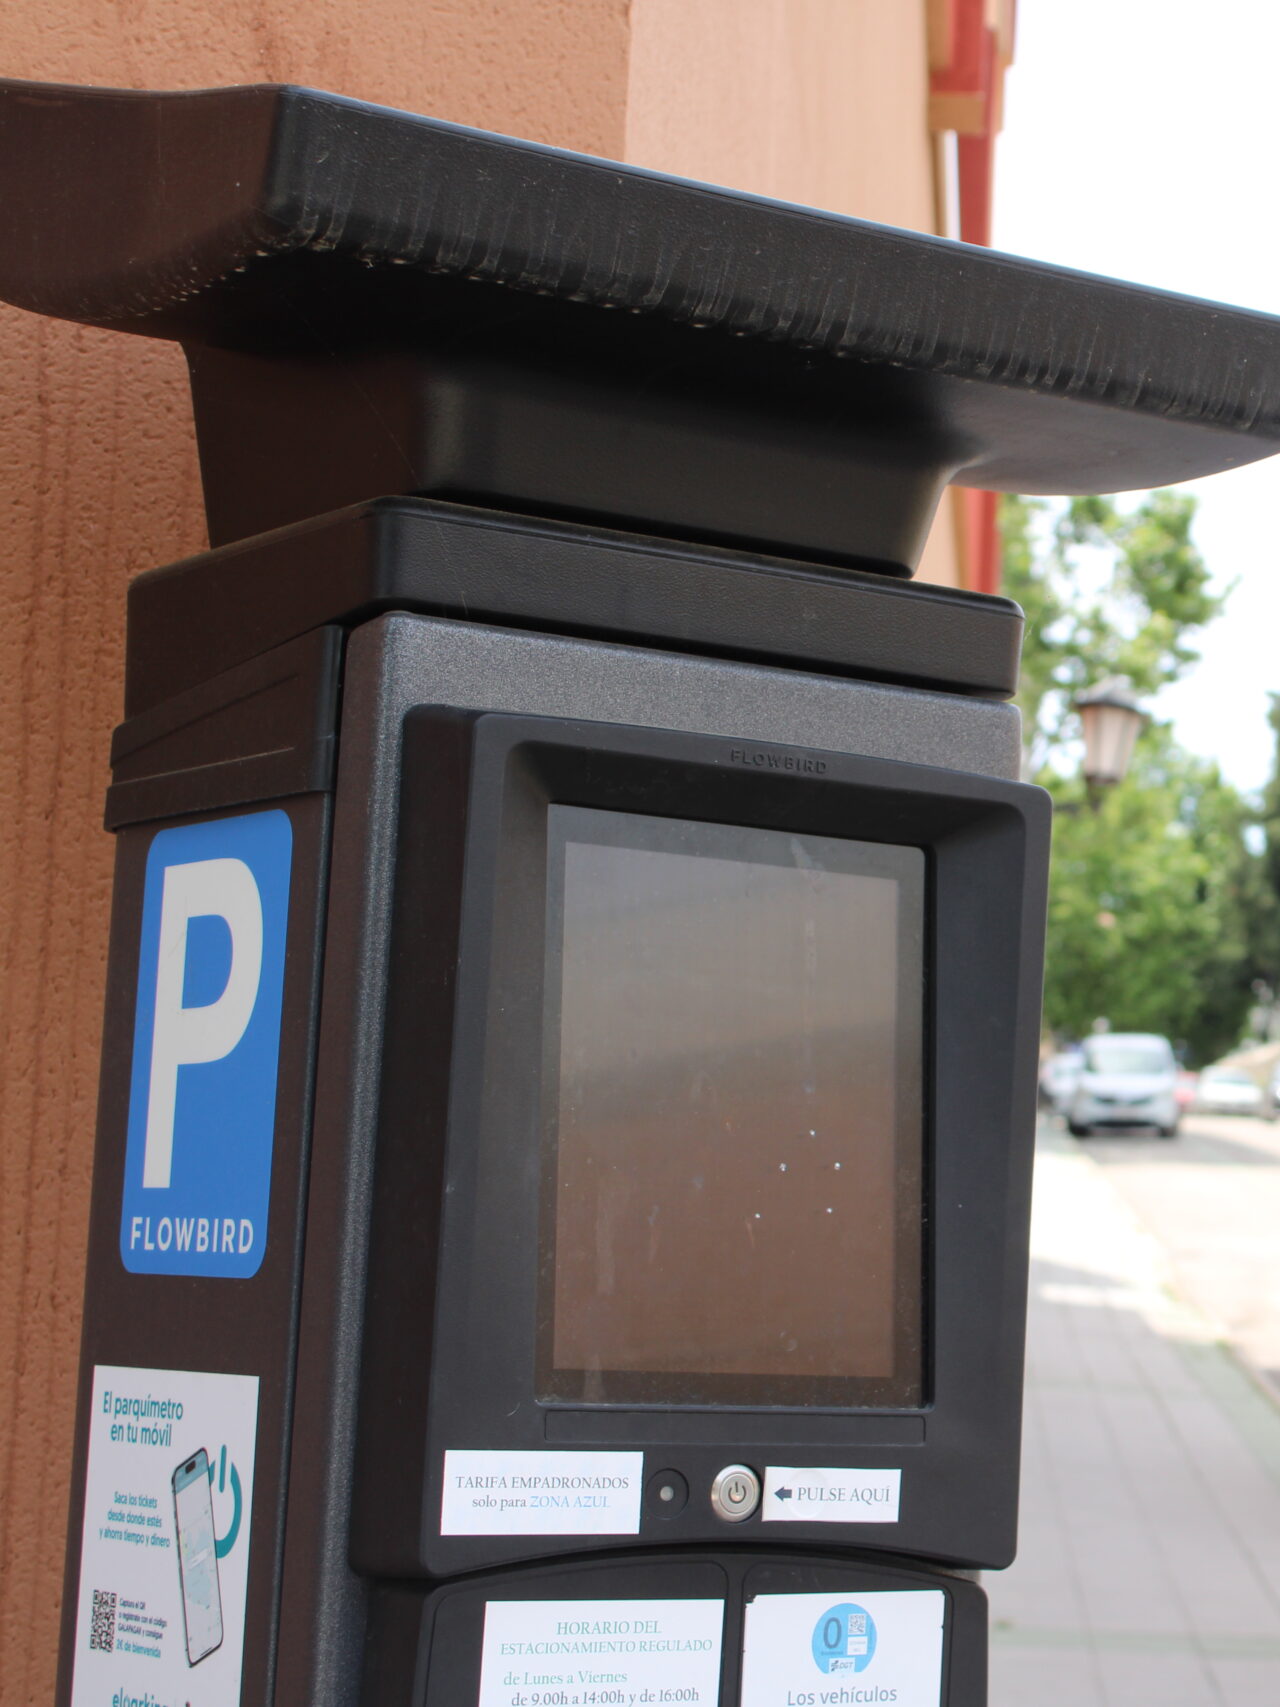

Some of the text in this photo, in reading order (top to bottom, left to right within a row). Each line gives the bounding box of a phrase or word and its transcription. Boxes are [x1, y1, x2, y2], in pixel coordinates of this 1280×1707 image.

[730, 748, 826, 774] FLOWBIRD
[142, 857, 263, 1189] P
[129, 1216, 254, 1254] FLOWBIRD
[103, 1391, 184, 1421] El parquímetro
[110, 1422, 173, 1447] en tu móvil
[456, 1476, 629, 1490] TARIFA EMPADRONADOS
[129, 1492, 137, 1506] los
[139, 1494, 158, 1509] tickets
[472, 1495, 610, 1513] solo para ZONA AZUL
[797, 1485, 891, 1506] PULSE AQUÍ
[107, 1509, 125, 1523] desde
[127, 1511, 145, 1526] donde
[556, 1620, 662, 1635] HORARIO DEL
[501, 1638, 713, 1655] ESTACIONAMIENTO REGULADO
[503, 1670, 628, 1686] de Lunes a Viernes
[511, 1687, 700, 1707] de 9.00h a 14:00h y de 16:00h
[787, 1686, 897, 1706] Los vehículos
